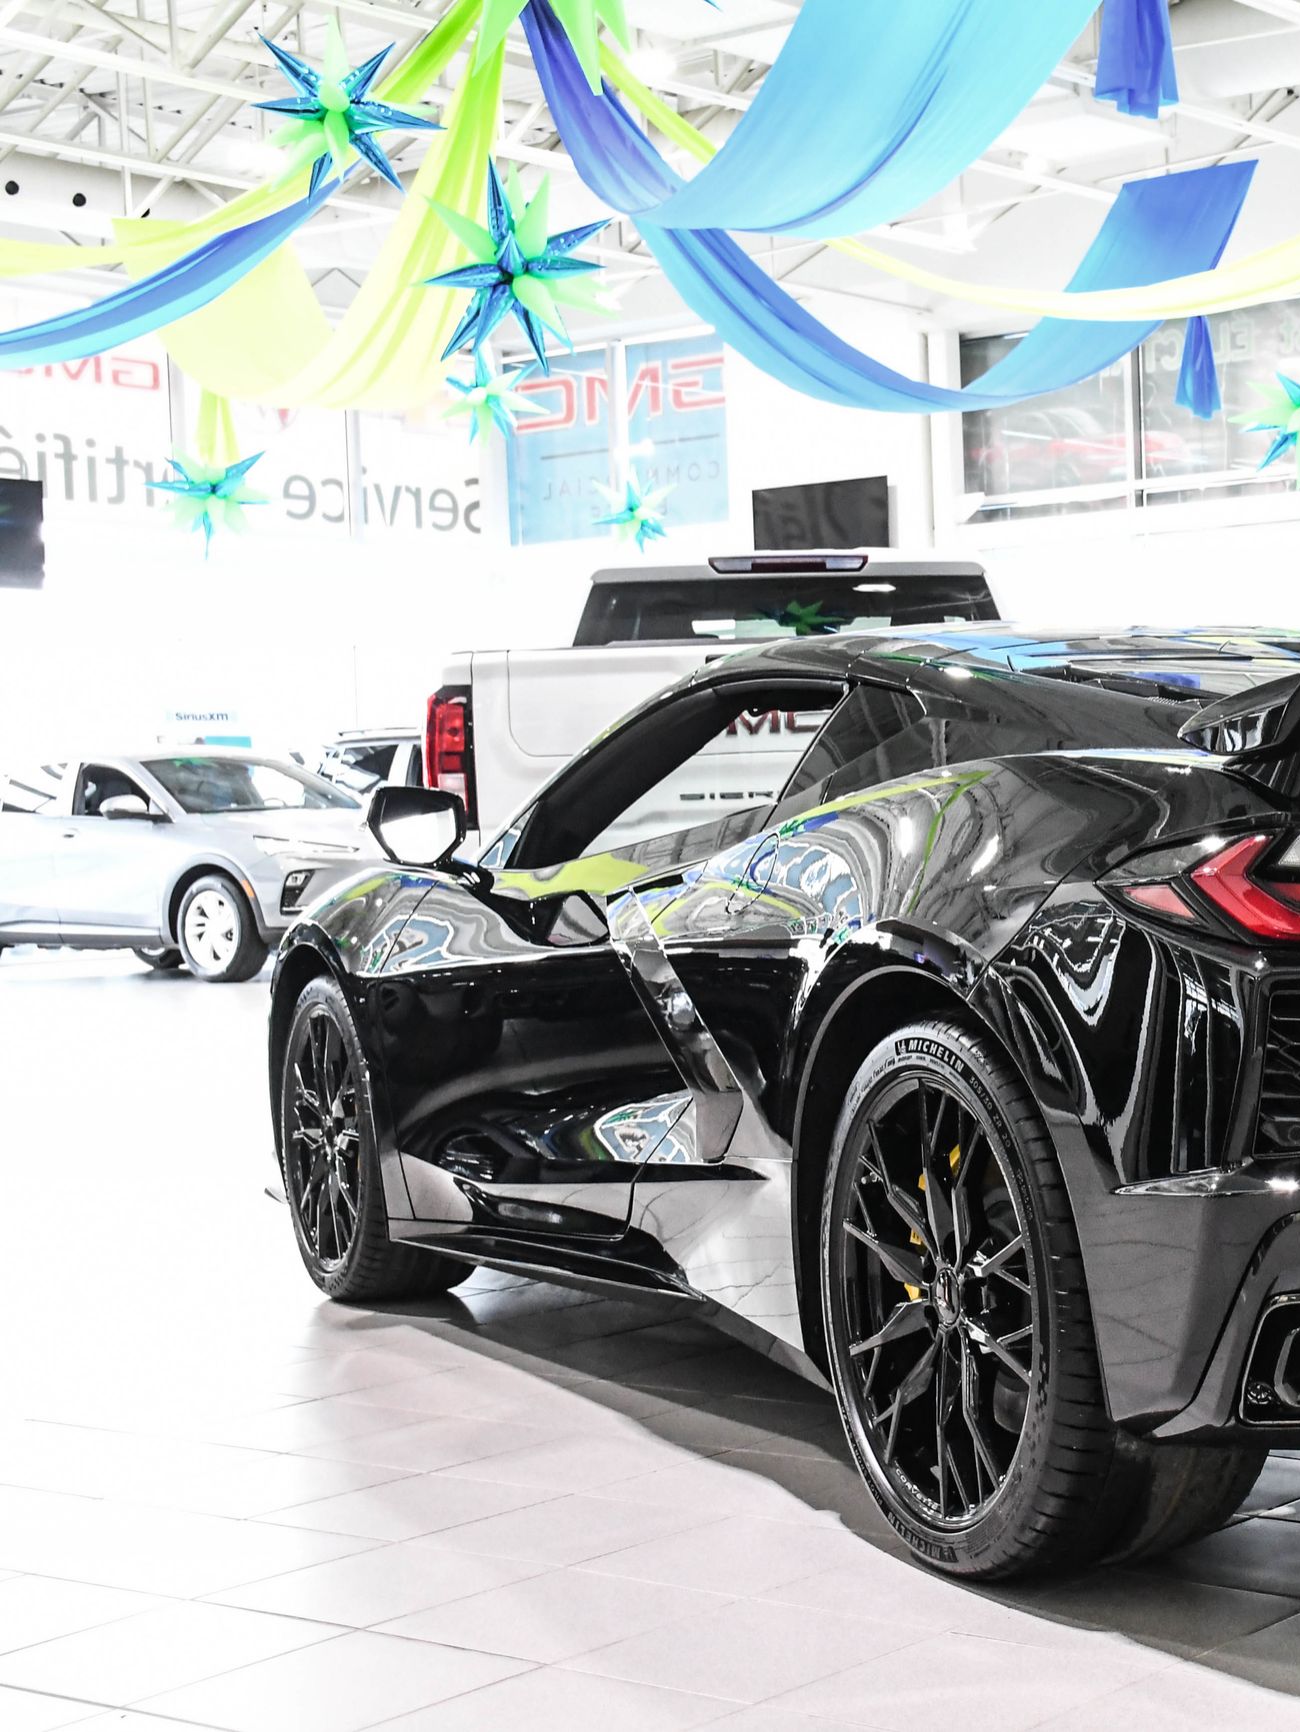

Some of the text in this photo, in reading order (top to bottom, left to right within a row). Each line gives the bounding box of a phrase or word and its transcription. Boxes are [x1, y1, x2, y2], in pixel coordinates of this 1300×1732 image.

[726, 709, 831, 736] MC
[680, 791, 780, 801] SIER
[908, 1039, 965, 1073] MICHELIN
[895, 1468, 939, 1510] CORVETTE
[888, 1511, 941, 1559] MICHELIN
